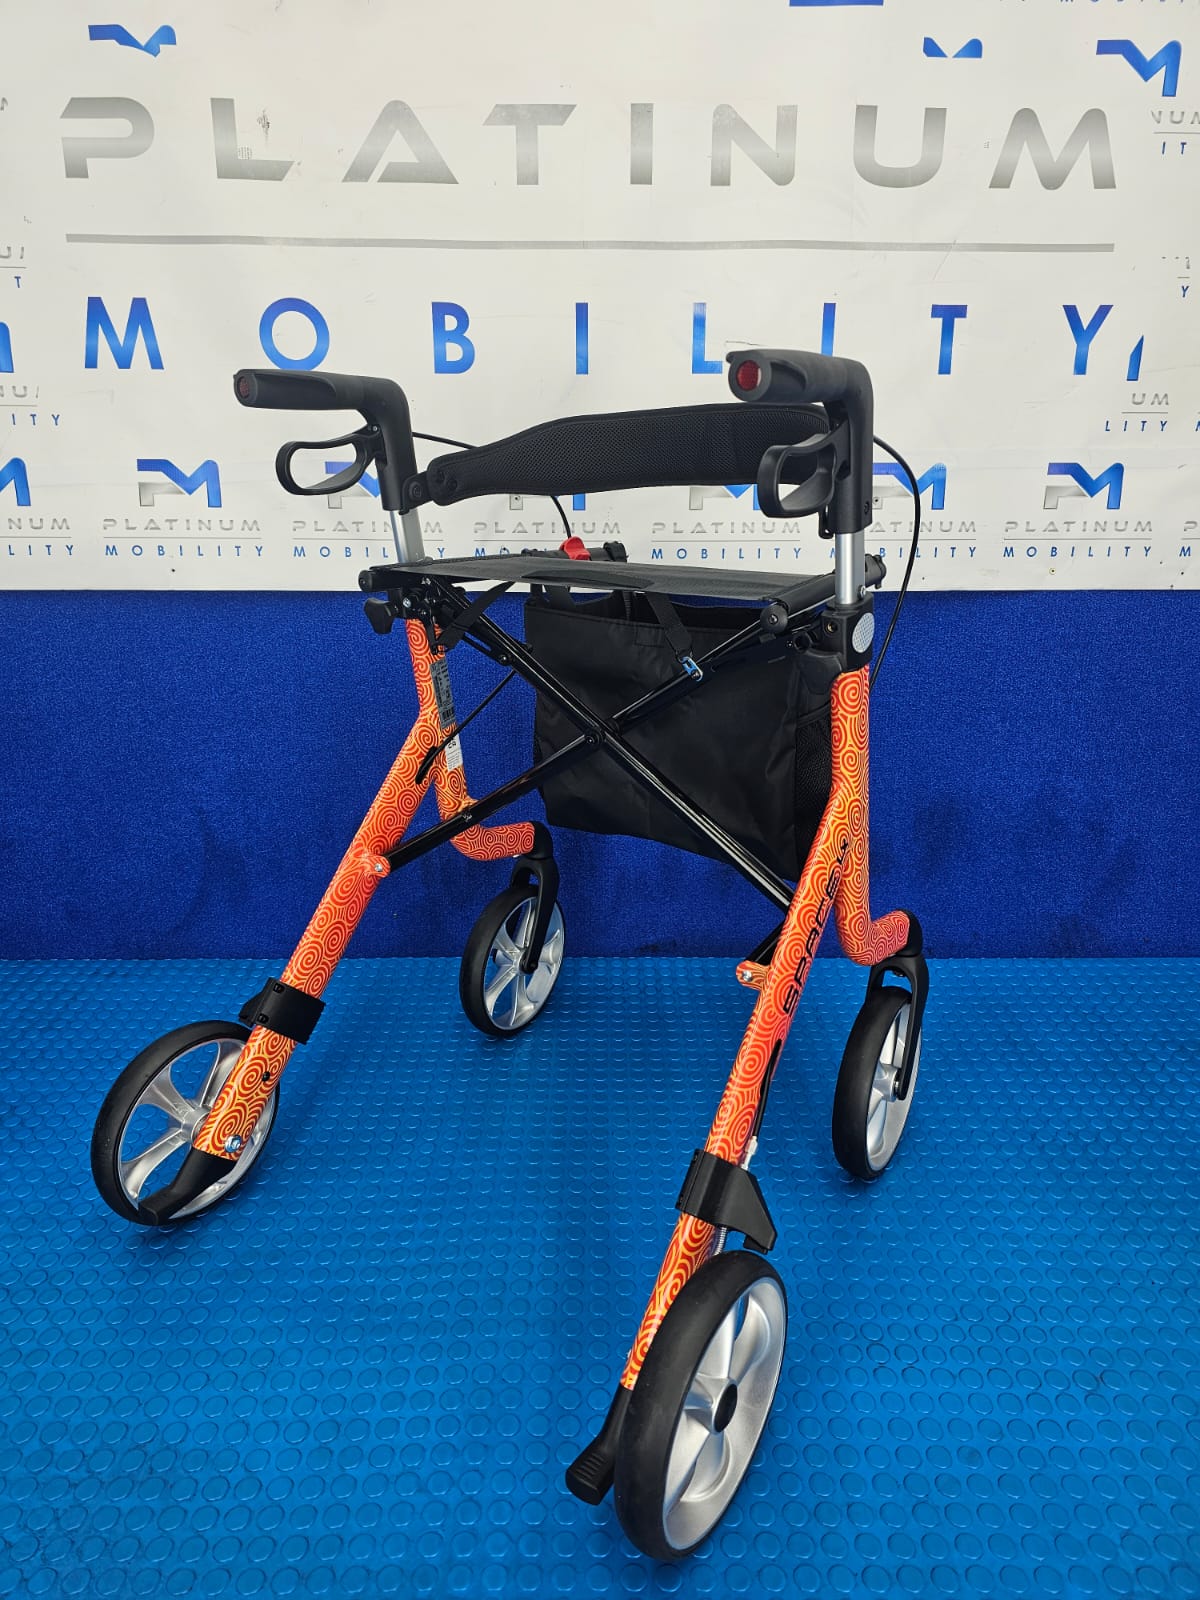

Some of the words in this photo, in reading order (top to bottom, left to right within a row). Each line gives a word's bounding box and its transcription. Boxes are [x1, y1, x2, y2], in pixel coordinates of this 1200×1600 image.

[60, 97, 1117, 190] PLATINUM
[84, 297, 1114, 376] MOBILITY
[103, 518, 261, 532] PLATINUM
[292, 520, 443, 533] PLATINM
[651, 521, 801, 534] PLATINUM
[869, 521, 977, 533] ATINUM
[1004, 520, 1153, 533] PLATINUM
[105, 544, 263, 557] MOBILITY
[293, 546, 445, 558] MOBILY
[651, 548, 802, 560] MOBILITY
[1003, 546, 1152, 558] MOBILITY
